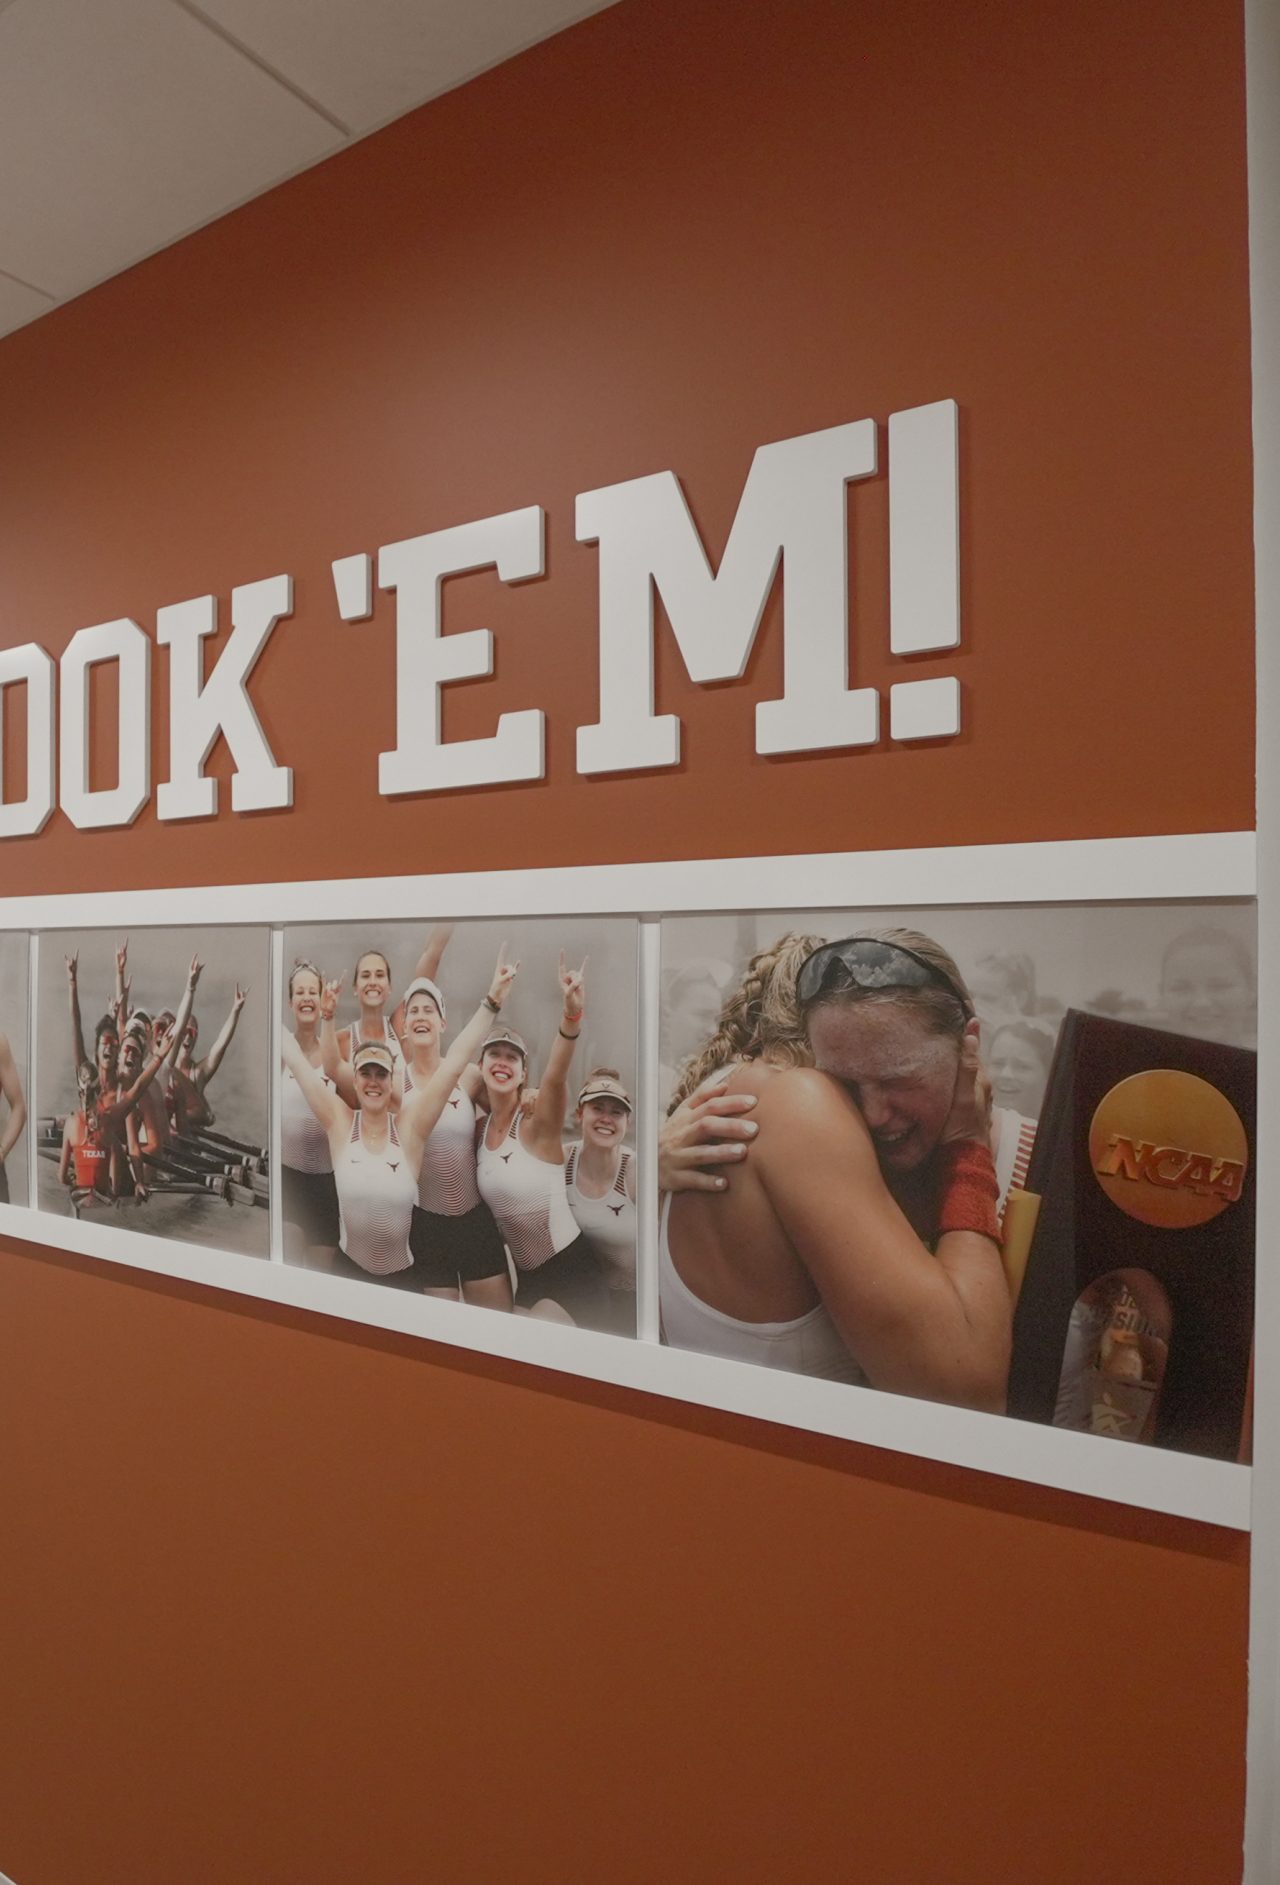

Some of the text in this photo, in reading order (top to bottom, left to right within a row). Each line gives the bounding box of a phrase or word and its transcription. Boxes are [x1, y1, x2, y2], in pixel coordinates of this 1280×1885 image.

[331, 398, 963, 797] 'EM!
[81, 1149, 106, 1159] TEXAS
[1097, 1133, 1246, 1203] NCAA
